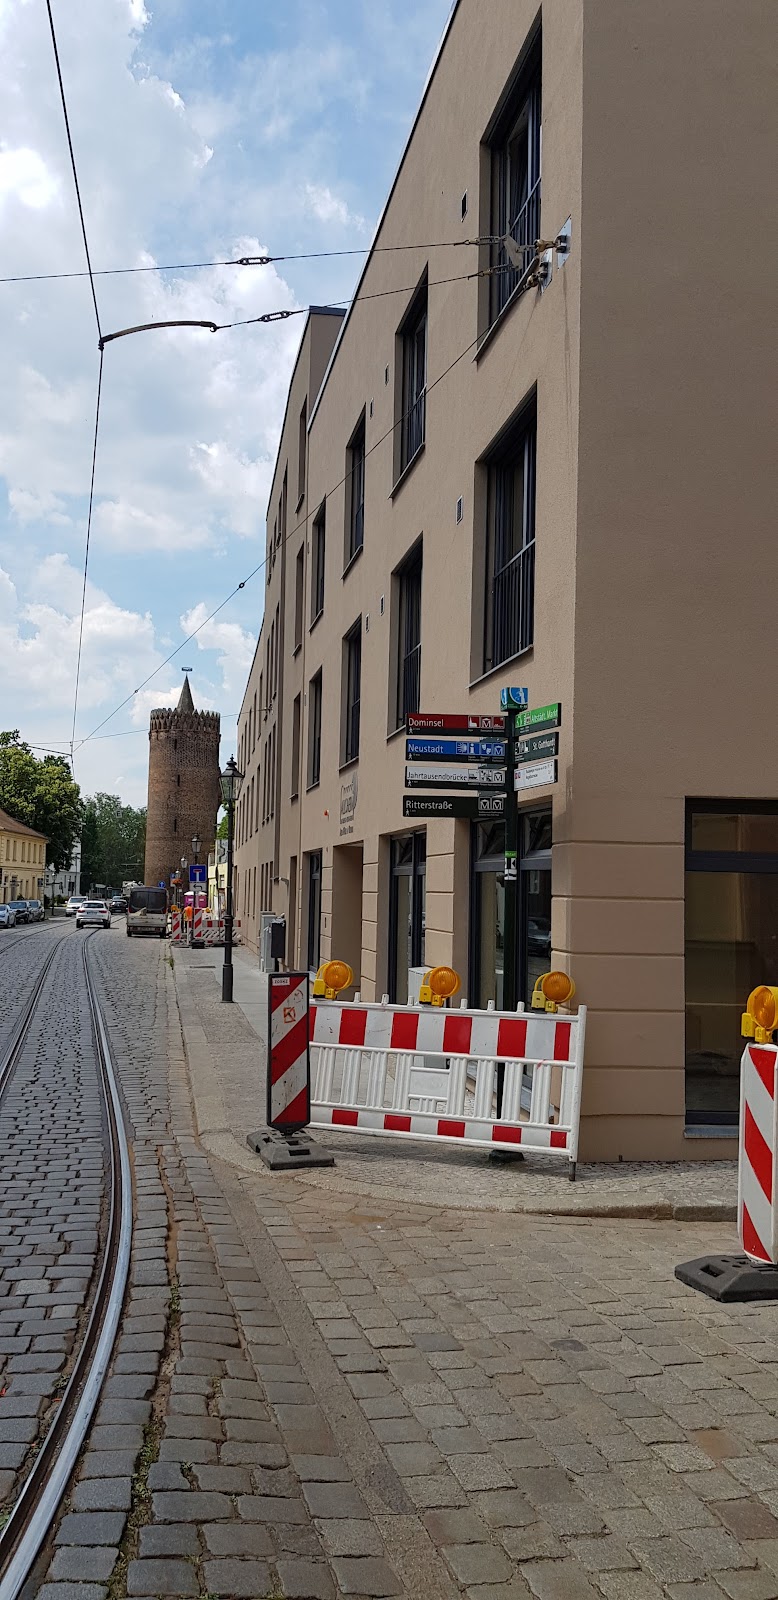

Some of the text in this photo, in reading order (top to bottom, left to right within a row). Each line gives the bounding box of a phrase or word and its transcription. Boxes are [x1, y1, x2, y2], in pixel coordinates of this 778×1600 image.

[408, 717, 444, 727] Dominsel
[408, 743, 444, 754] Neustadt
[407, 771, 468, 782] Jahrtausendbrücke
[405, 800, 453, 810] Ritterstraße
